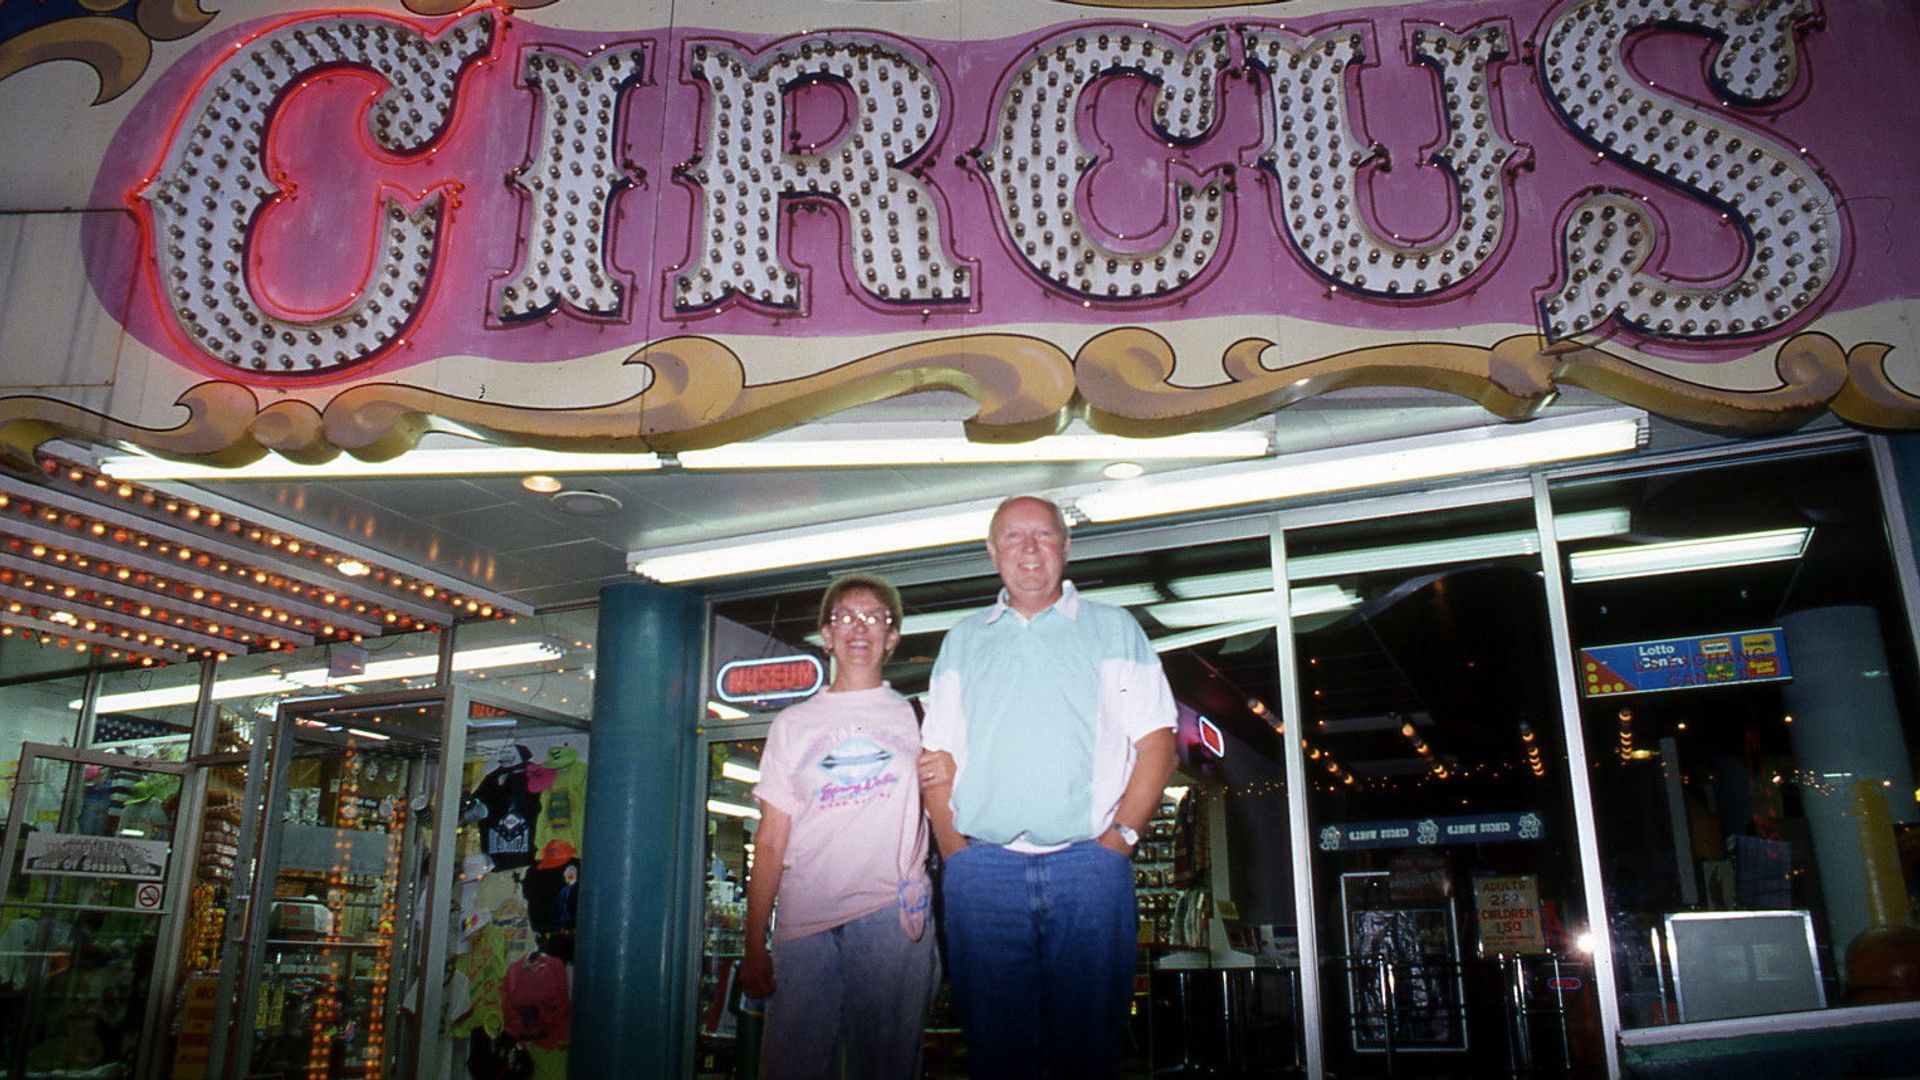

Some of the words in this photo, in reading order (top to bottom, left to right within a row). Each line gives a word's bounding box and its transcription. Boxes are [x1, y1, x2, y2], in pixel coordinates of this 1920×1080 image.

[137, 0, 1825, 388] CIRCUS
[1639, 645, 1675, 656] Lotto
[725, 660, 817, 695] MUSEUM
[1483, 881, 1527, 891] ADULTS
[1482, 907, 1535, 920] CHILDREN
